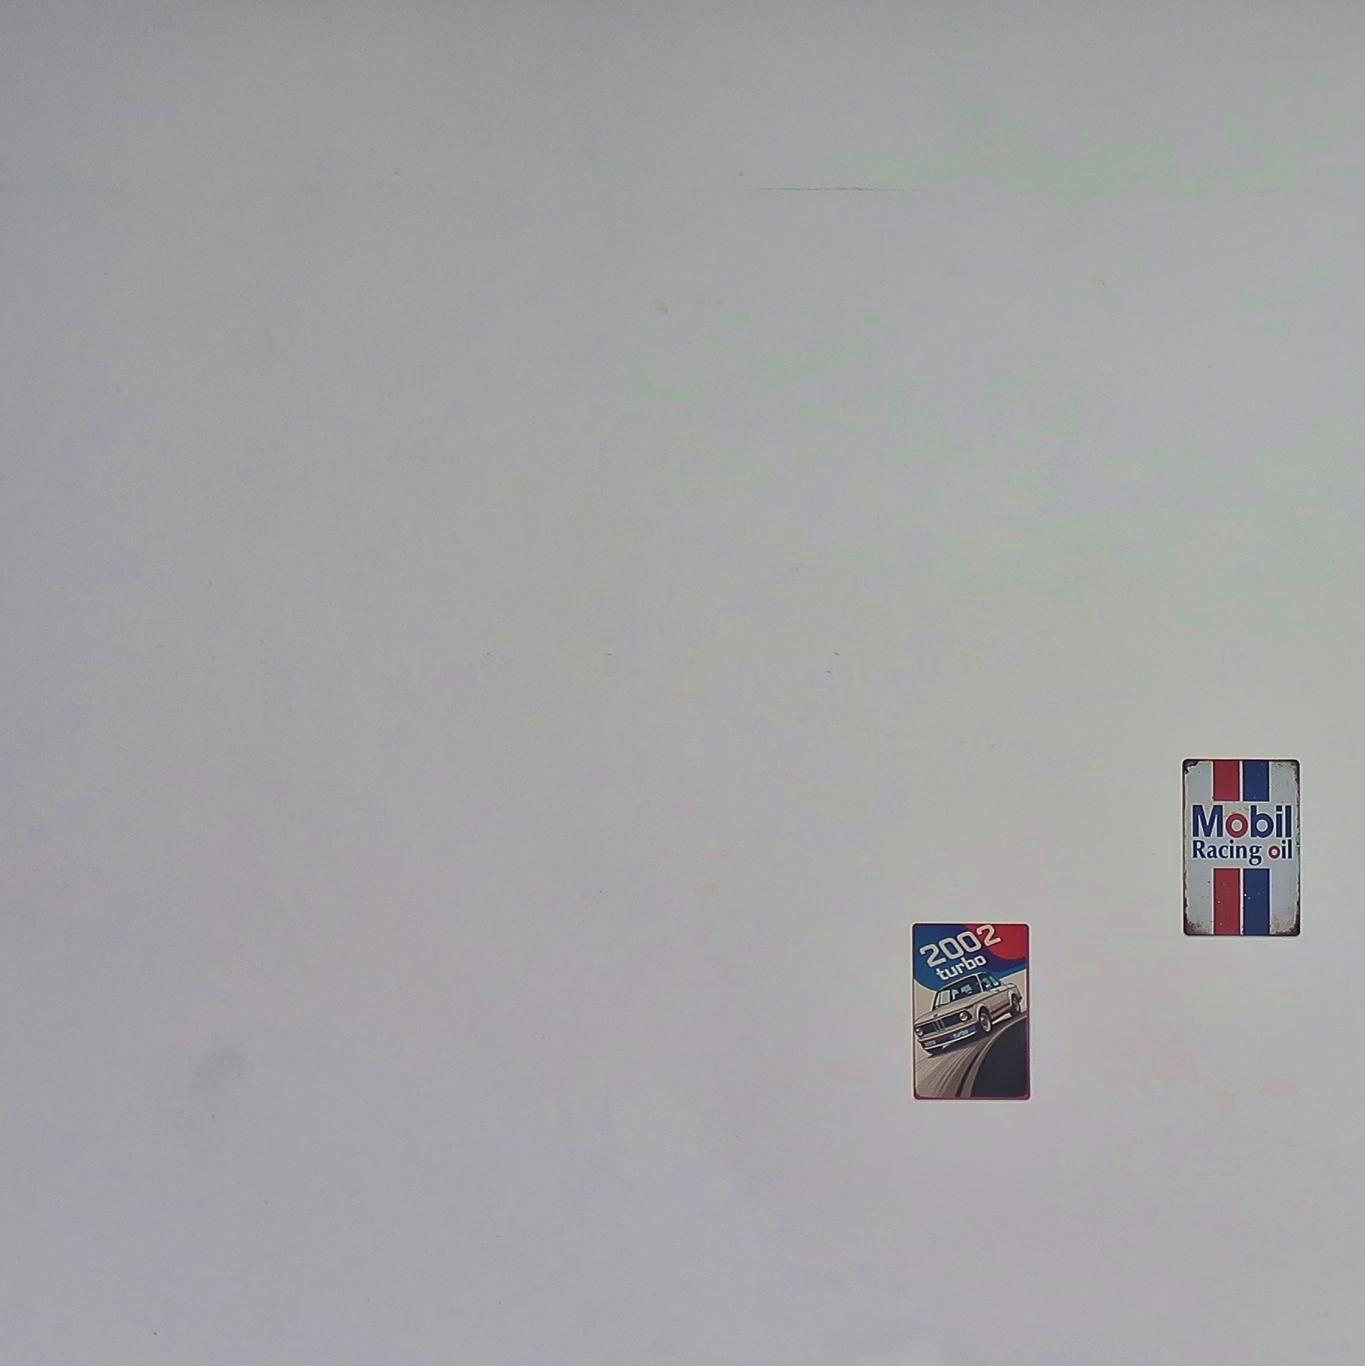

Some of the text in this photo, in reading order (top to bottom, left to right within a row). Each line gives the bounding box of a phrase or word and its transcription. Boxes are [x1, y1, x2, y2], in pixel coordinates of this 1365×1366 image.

[1192, 804, 1292, 838] Mobil
[1192, 839, 1293, 866] Racing oil
[919, 924, 1002, 968] 2002
[935, 955, 987, 981] turbo
